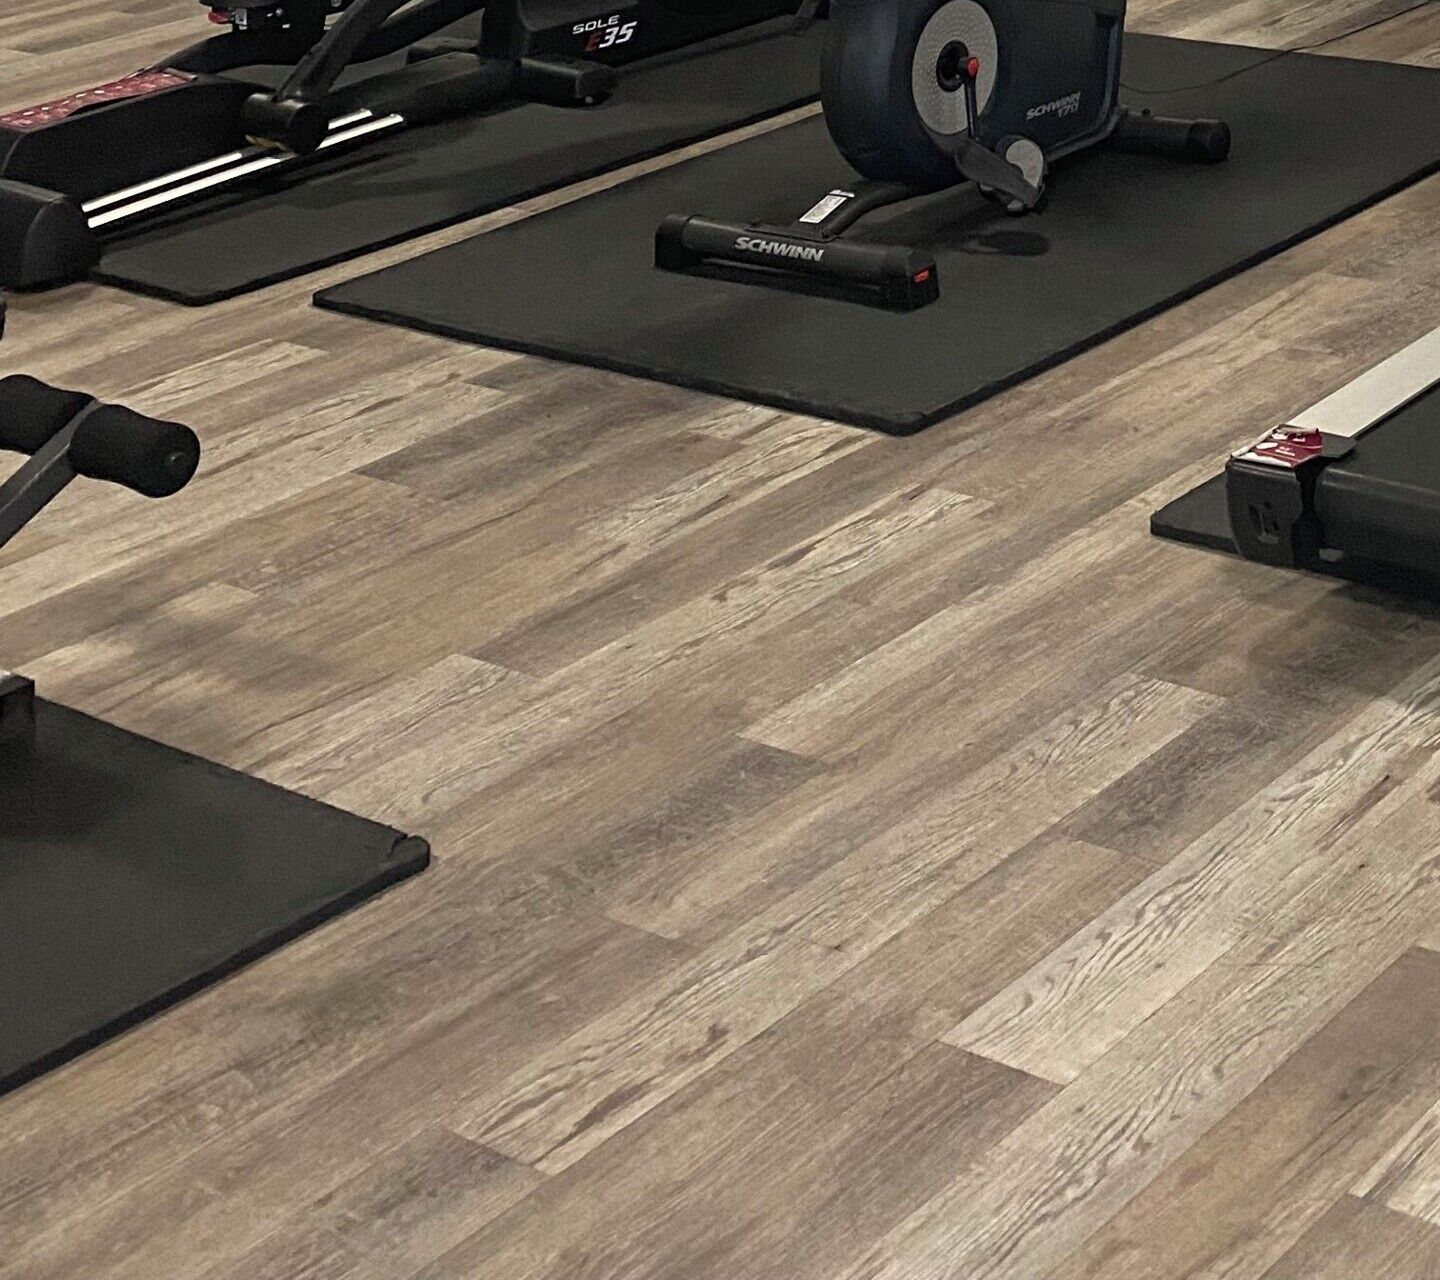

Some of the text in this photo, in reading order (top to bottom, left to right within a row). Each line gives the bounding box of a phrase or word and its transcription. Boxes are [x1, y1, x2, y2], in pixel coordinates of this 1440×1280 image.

[572, 14, 620, 35] SOLE
[585, 21, 638, 52] E35
[1025, 91, 1081, 120] SCHWINN
[735, 237, 824, 262] SCHWINN
